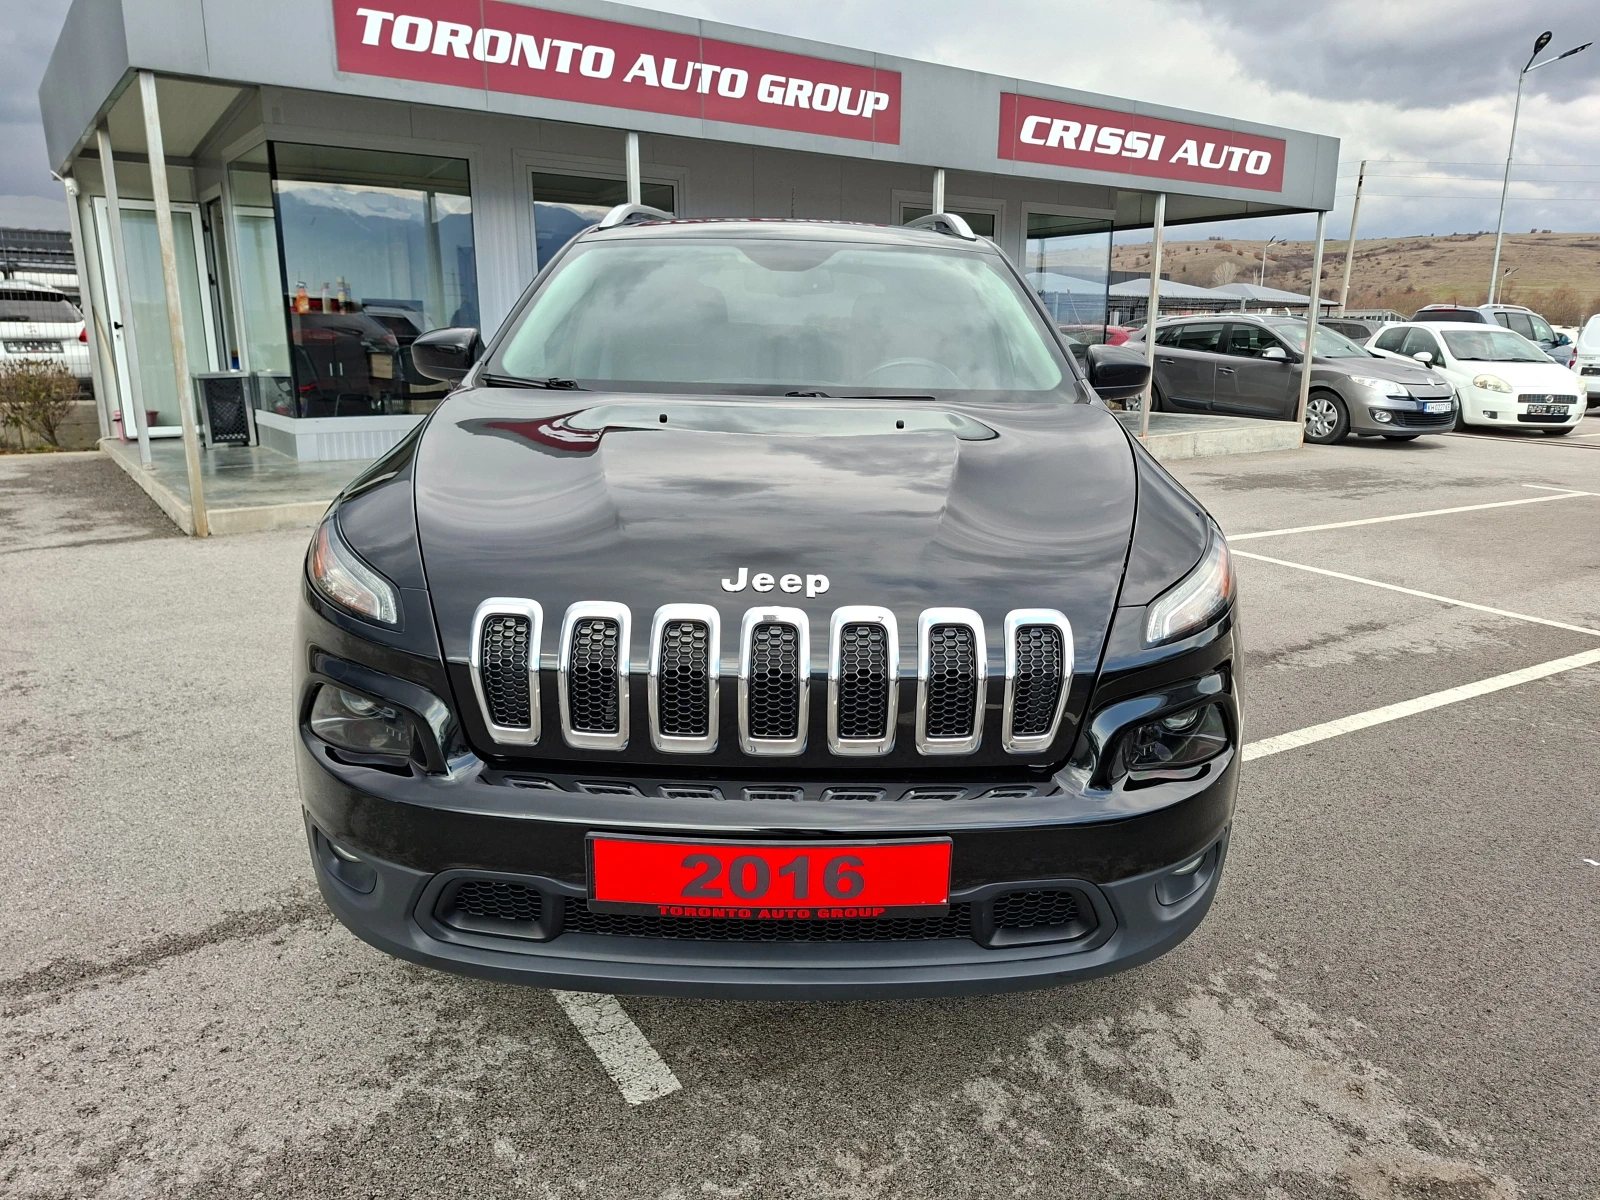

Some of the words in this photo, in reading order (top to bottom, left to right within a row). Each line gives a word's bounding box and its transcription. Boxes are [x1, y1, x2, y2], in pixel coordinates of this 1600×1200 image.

[356, 8, 615, 78] TORONTO
[623, 54, 748, 98] AUTO
[757, 74, 889, 118] GROUP
[1020, 116, 1165, 160] CRISSI
[1169, 140, 1271, 175] AUTO
[721, 567, 830, 598] Jeep
[681, 854, 865, 899] 2016
[657, 906, 752, 919] TORONTO
[758, 909, 811, 919] AUTO
[818, 907, 886, 919] GROUP
